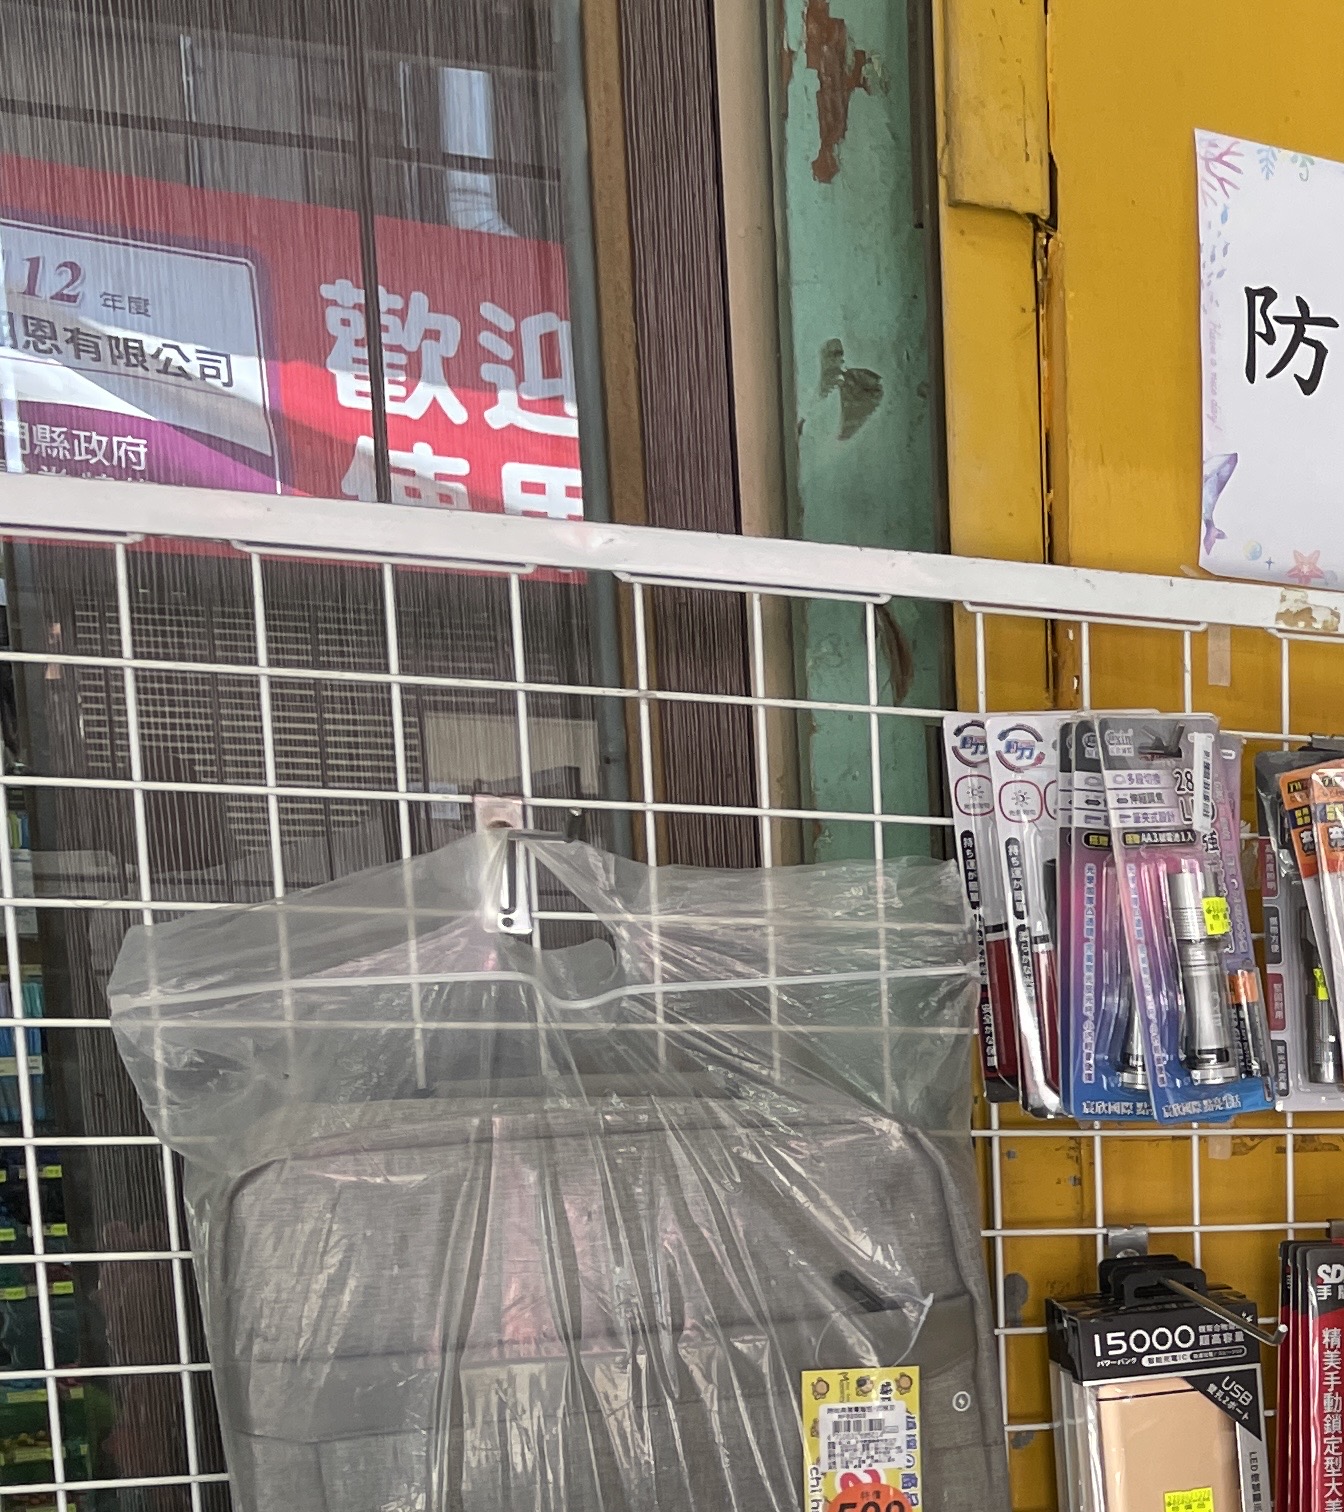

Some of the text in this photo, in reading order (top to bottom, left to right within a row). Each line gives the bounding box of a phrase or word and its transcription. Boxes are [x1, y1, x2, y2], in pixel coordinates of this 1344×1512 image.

[99, 290, 152, 318] 年度
[6, 310, 234, 388] 恩有限公司
[319, 278, 578, 437] 歡迎
[1094, 1324, 1196, 1357] 15000
[1221, 1375, 1253, 1406] USB
